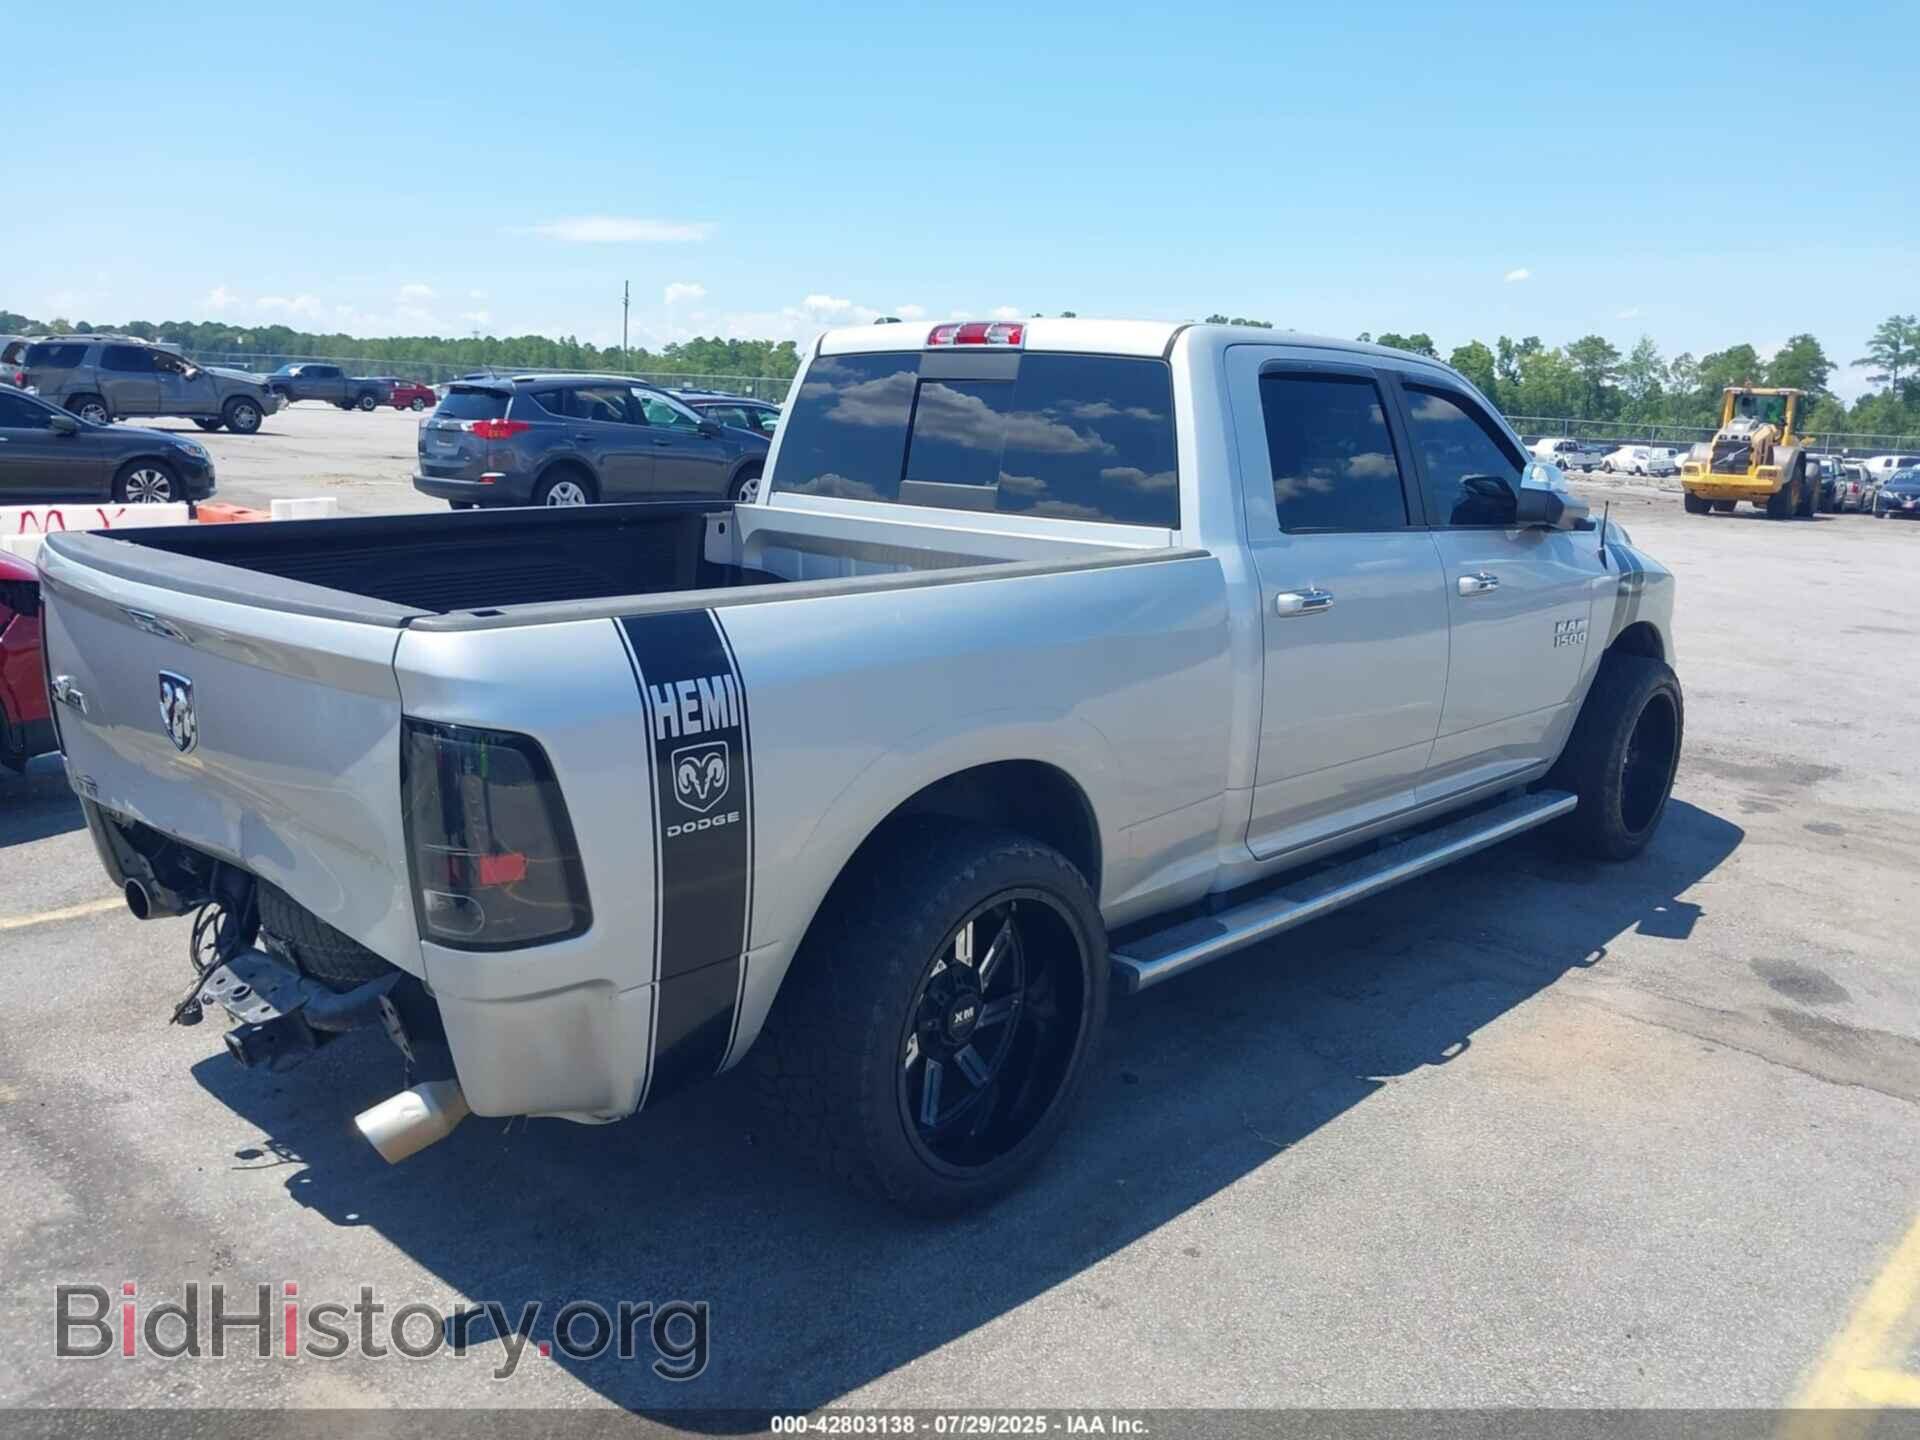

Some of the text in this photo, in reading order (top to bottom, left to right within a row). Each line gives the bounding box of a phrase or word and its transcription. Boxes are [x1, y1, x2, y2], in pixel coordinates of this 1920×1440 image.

[1553, 633, 1586, 648] 1500
[649, 673, 739, 740] HEMI
[667, 811, 740, 837] DODGE
